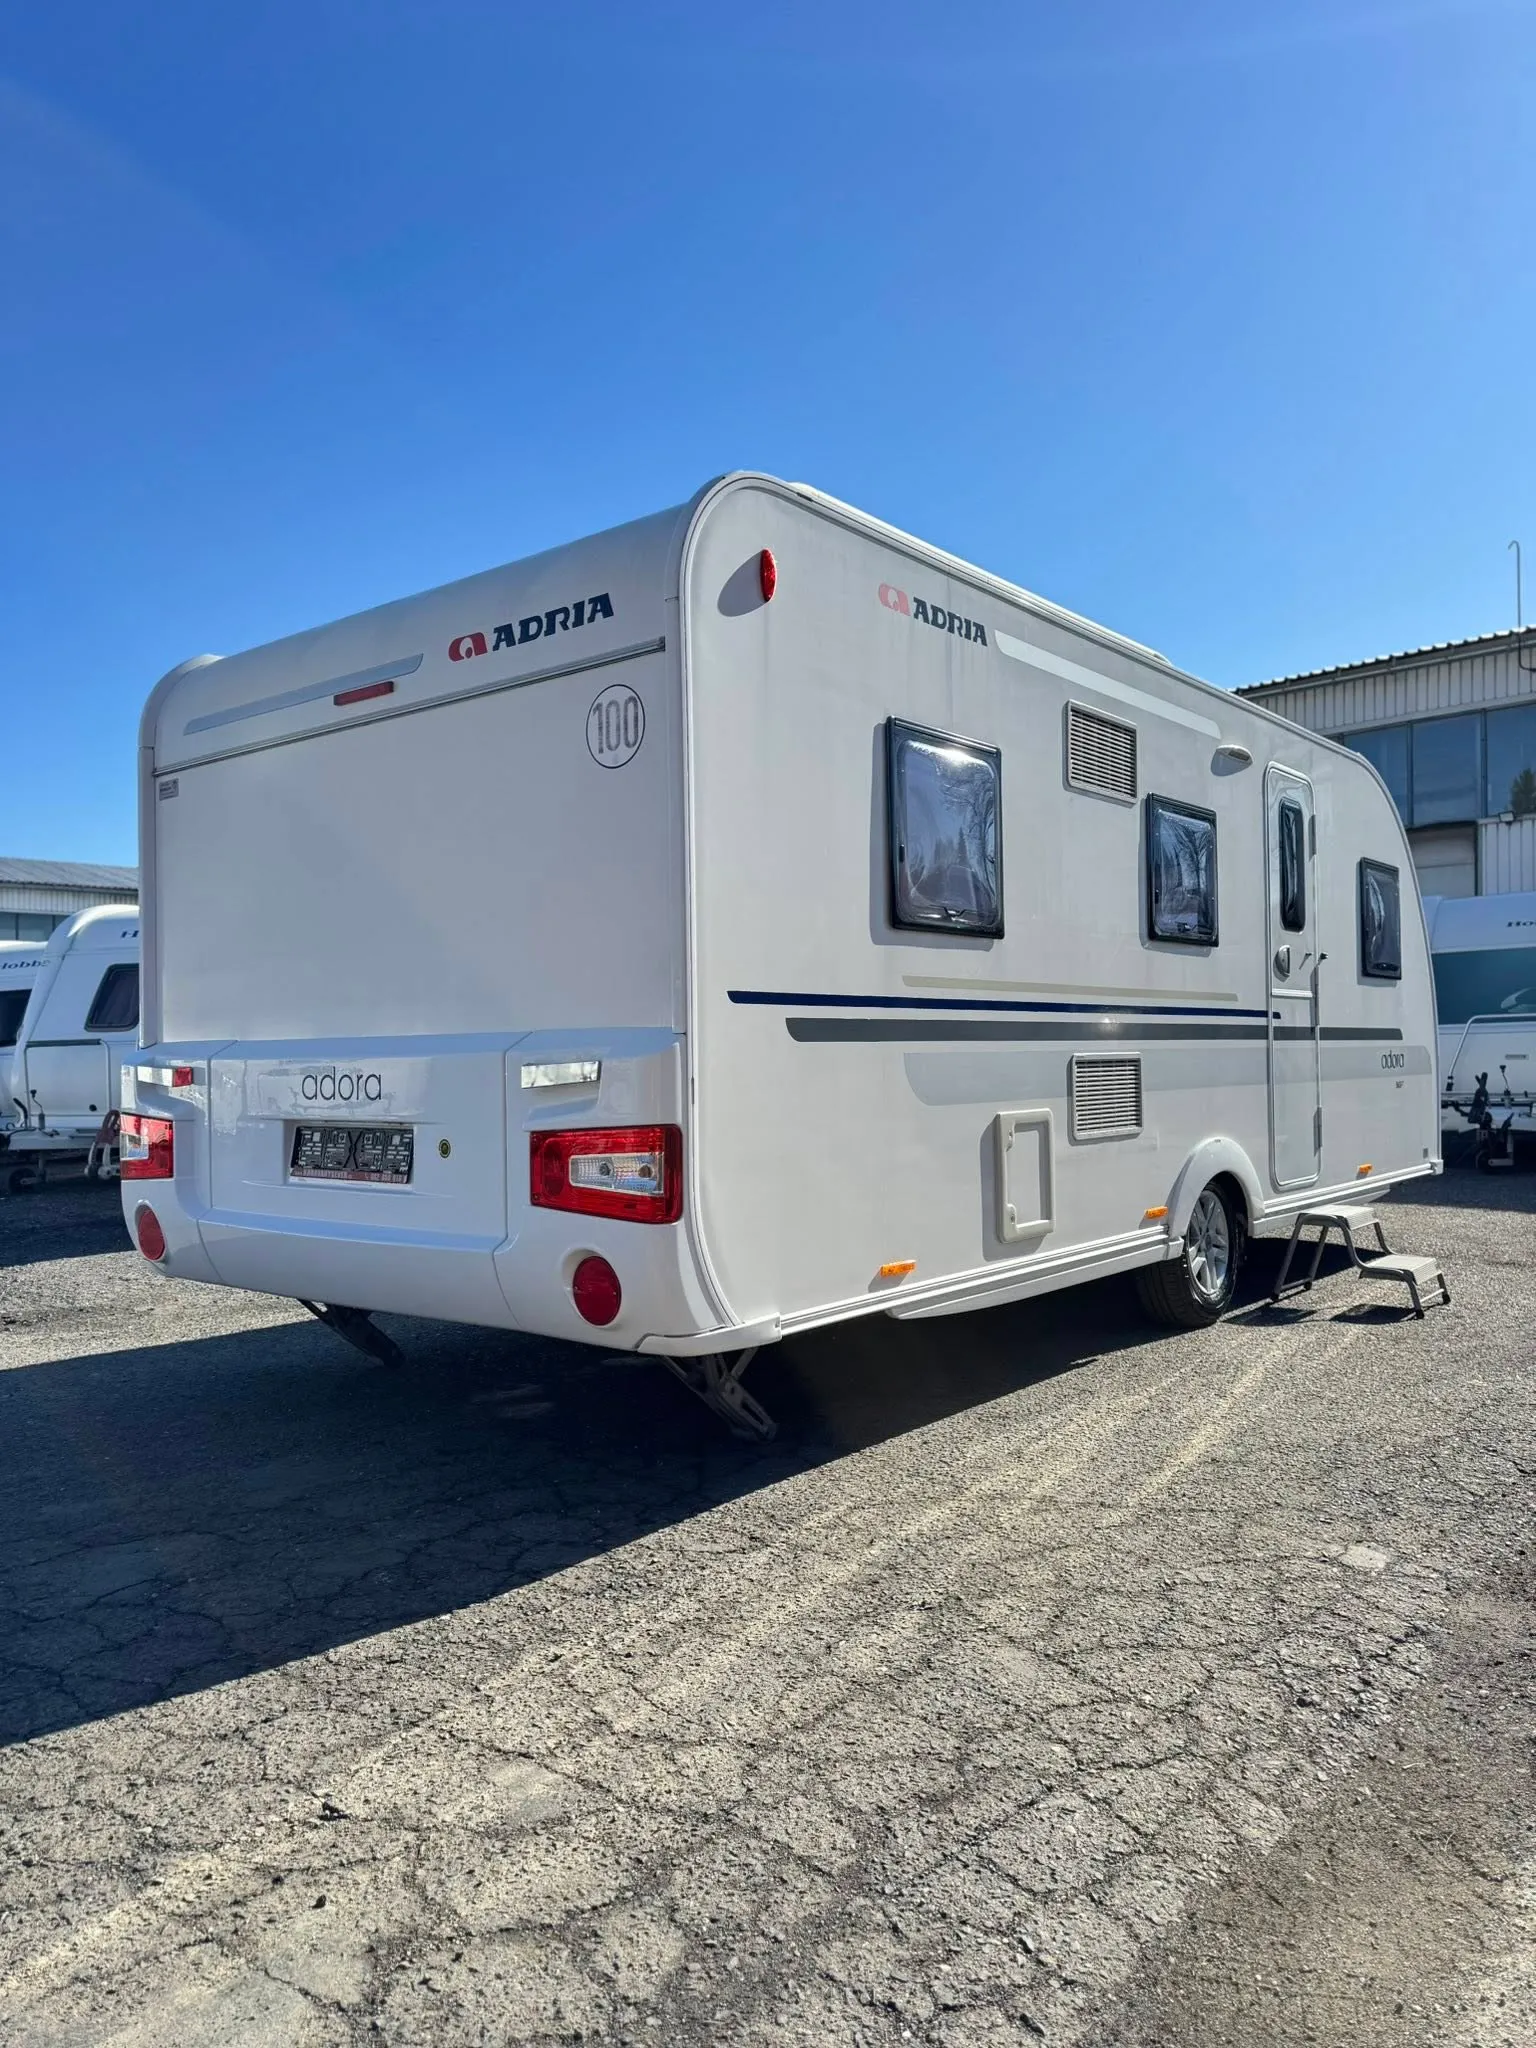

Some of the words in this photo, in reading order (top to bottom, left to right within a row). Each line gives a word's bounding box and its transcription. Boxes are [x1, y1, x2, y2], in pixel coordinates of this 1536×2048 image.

[492, 592, 615, 652] ADRIA
[913, 596, 988, 647] ADRIA
[592, 696, 639, 754] 100
[301, 1066, 382, 1101] adora
[1381, 1049, 1405, 1070] adora
